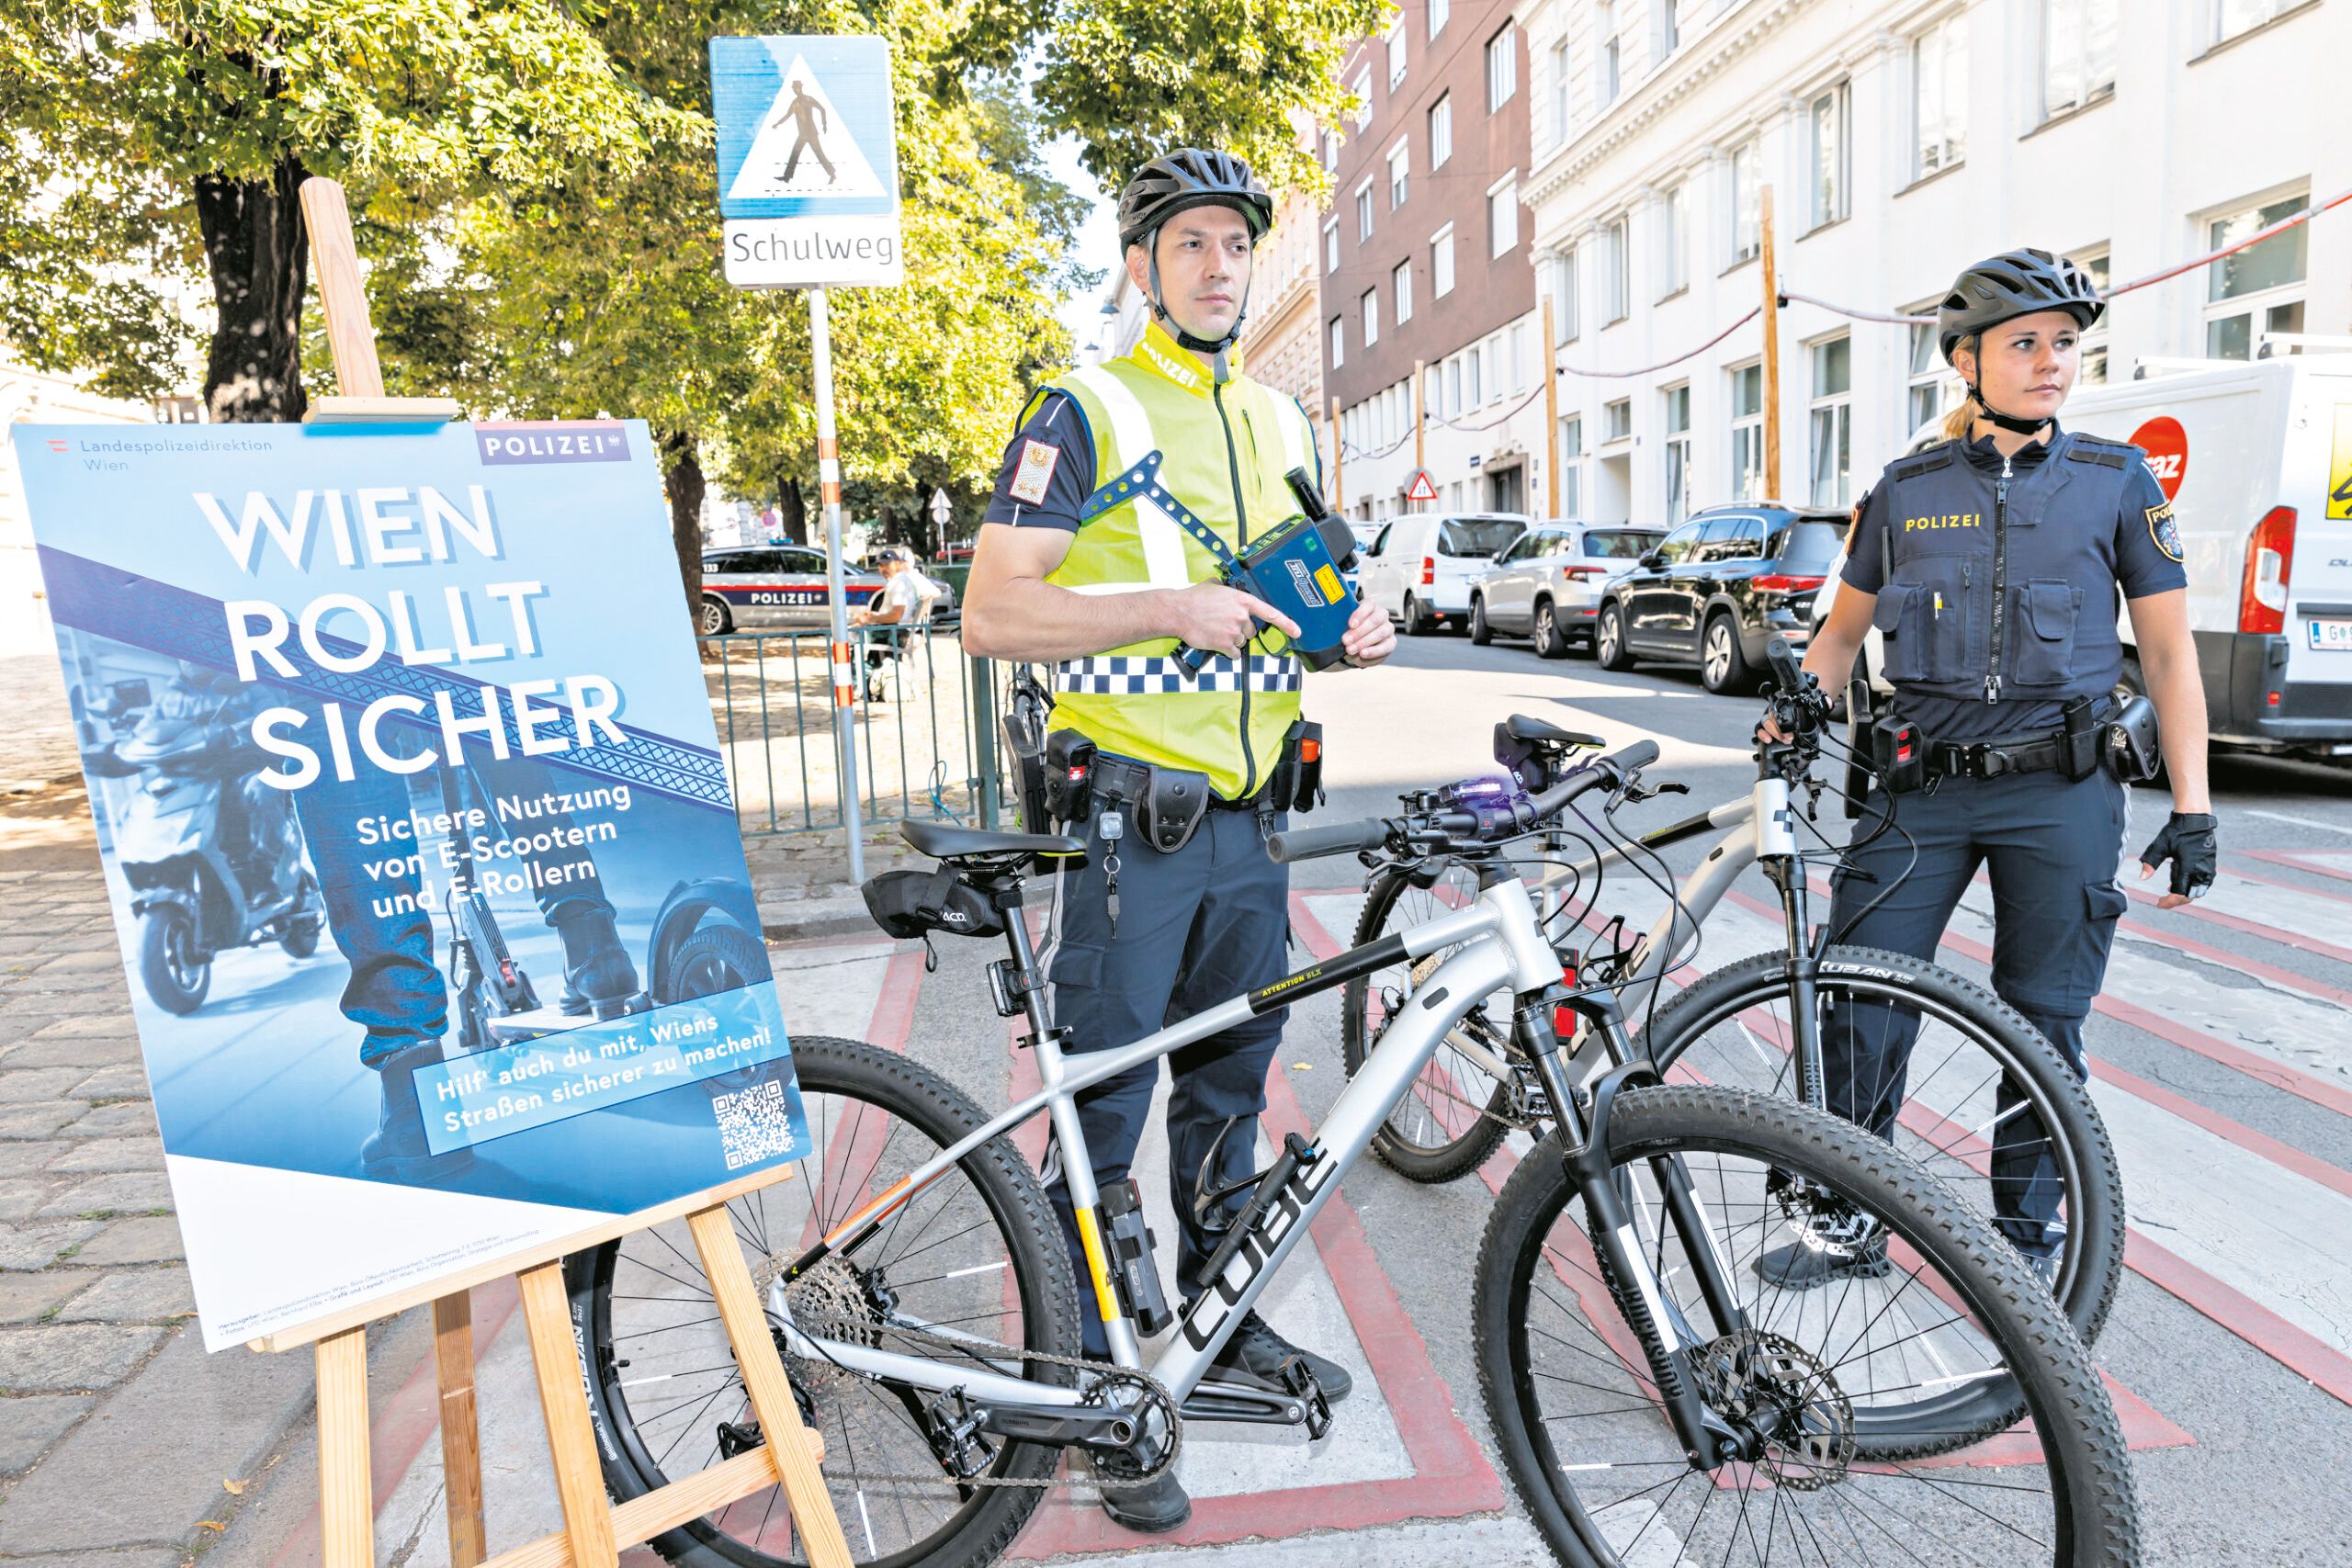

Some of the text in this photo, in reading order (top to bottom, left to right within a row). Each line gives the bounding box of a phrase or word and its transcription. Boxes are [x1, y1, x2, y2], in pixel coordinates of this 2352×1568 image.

[732, 232, 893, 265] Schulweg
[80, 439, 273, 455] Landespolizeidirektion
[83, 458, 129, 471] Wien
[484, 435, 605, 457] POLIZEI
[192, 484, 501, 574] WIEN
[1905, 513, 1980, 532] POLIZEI
[703, 563, 719, 573] 133
[751, 592, 812, 604] POLIZEI
[223, 581, 543, 682] ROLLT
[251, 674, 630, 791] SICHER
[356, 784, 631, 845] Sichere Nutzung
[362, 821, 617, 882] von E-Scootern
[372, 860, 595, 919] und E-Rollern
[1262, 968, 1322, 998] ATTENTION SLX
[436, 1014, 719, 1102] Hilf' auch du mit, Wiens
[444, 1027, 773, 1133] Straßen sicherer zu machen!
